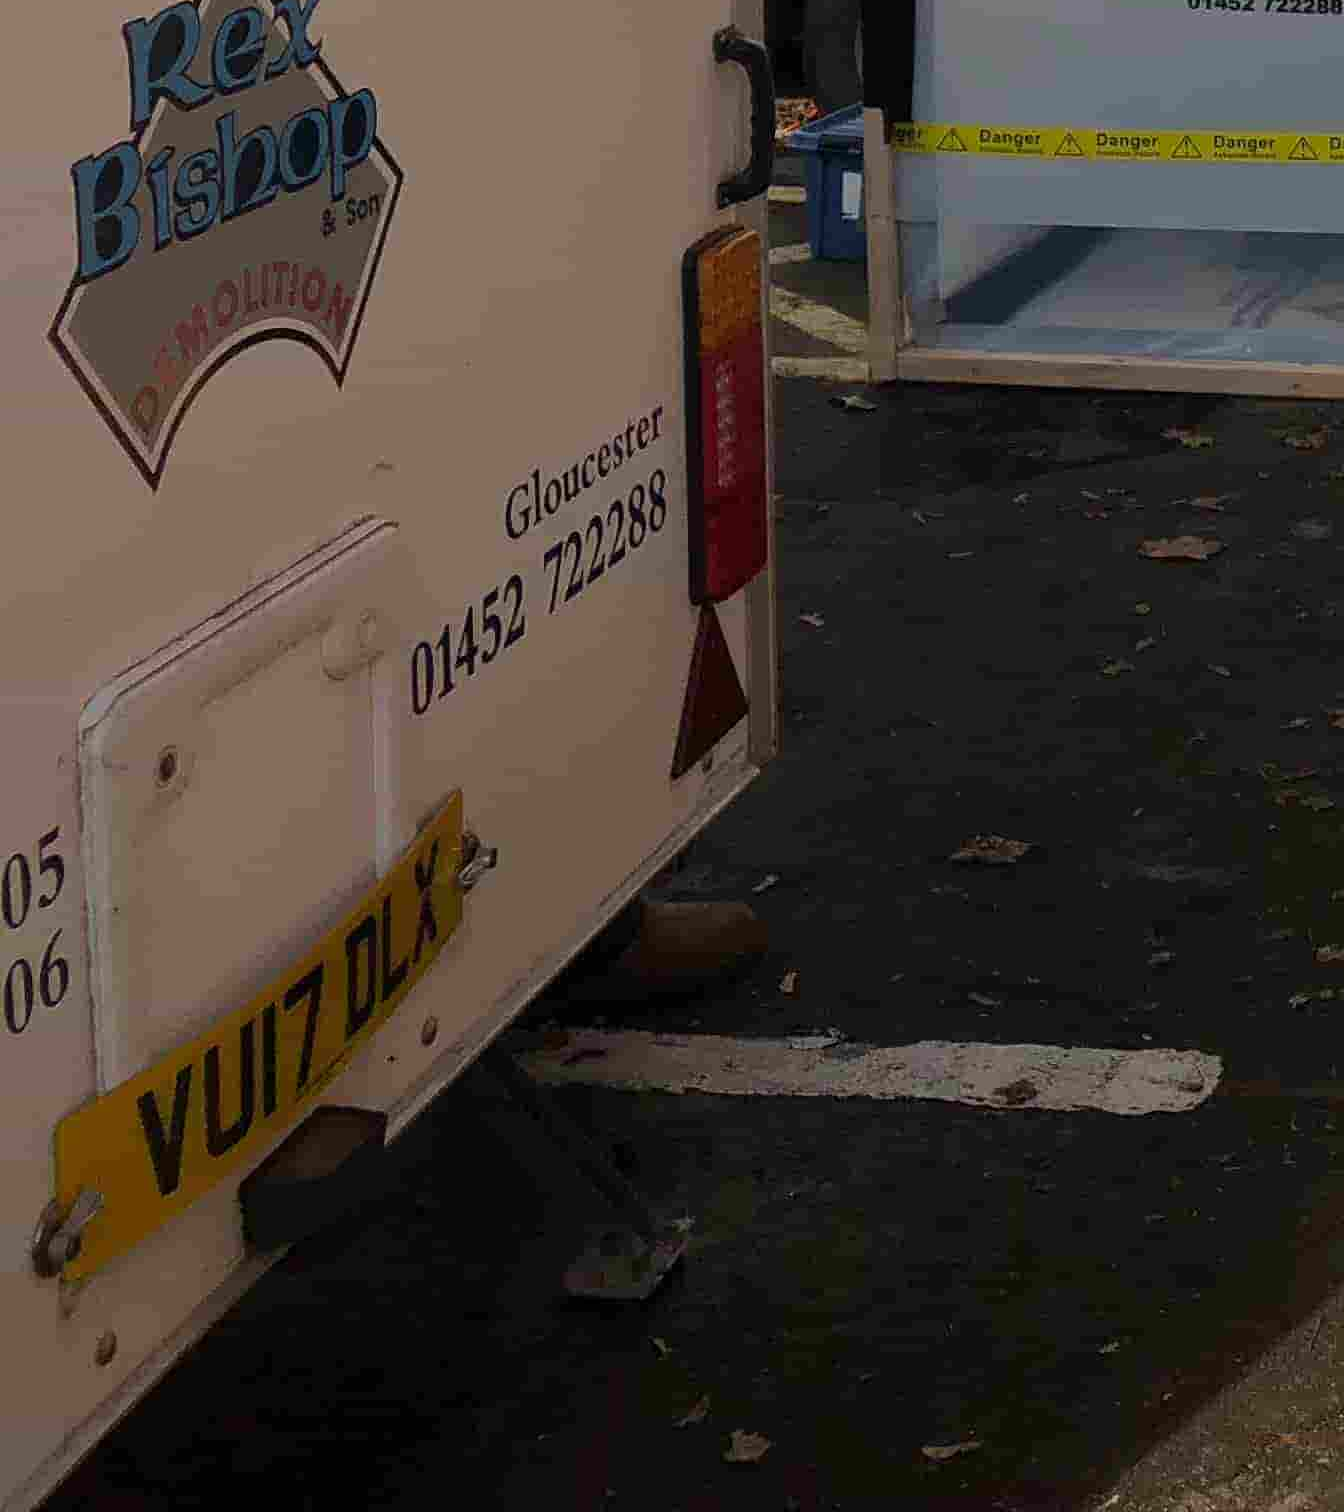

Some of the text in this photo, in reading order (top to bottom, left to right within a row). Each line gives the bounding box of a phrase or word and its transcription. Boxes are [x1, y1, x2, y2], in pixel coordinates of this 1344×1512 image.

[70, 88, 377, 285] Bishop
[345, 194, 383, 227] Son
[978, 128, 1041, 147] Danger
[1096, 131, 1159, 150] Danger
[1213, 135, 1277, 152] Danger
[130, 260, 352, 425] DEMOLITION
[505, 404, 663, 540] Gloucester
[411, 468, 668, 716] 01452 722288
[137, 839, 440, 1197] VU17 DLX
